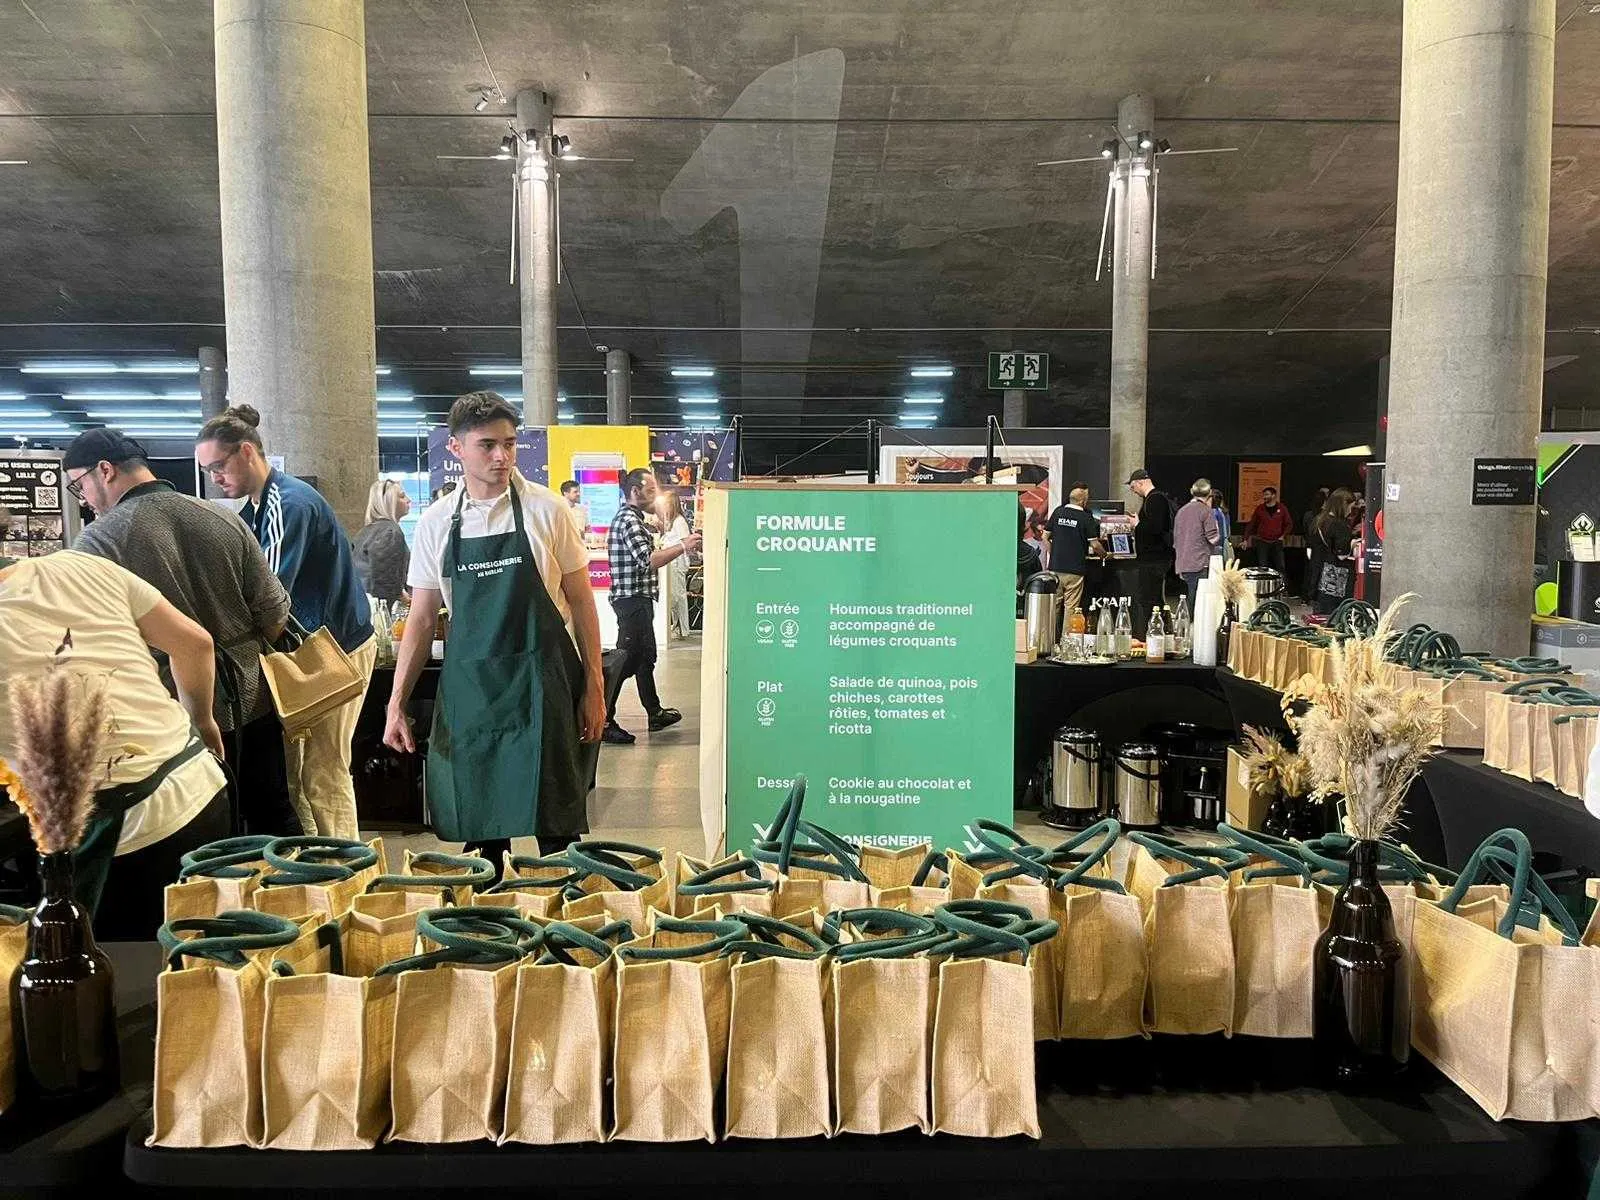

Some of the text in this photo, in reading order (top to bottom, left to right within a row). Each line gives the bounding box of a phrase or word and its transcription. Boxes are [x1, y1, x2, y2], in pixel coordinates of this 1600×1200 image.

[15, 471, 37, 479] LILLE
[756, 515, 847, 532] FORMULE
[756, 536, 877, 554] CROQUANTE
[457, 556, 523, 572] LA CONSIGNERIE
[756, 602, 801, 616] Entrée
[829, 603, 974, 616] Houmous traditionnel
[829, 619, 936, 634] accompagné de
[829, 634, 957, 649] légumes croquants
[757, 680, 783, 693] Plat
[829, 676, 979, 691] Salade de quinoa, pois
[829, 691, 944, 705] chiches, carottes
[829, 706, 946, 720] rôties, tomates et
[829, 722, 872, 735] ricotta
[829, 776, 973, 790] Cookie au chocolat et
[828, 792, 921, 808] à la nougatine
[841, 834, 934, 847] ONSIGNERIE
